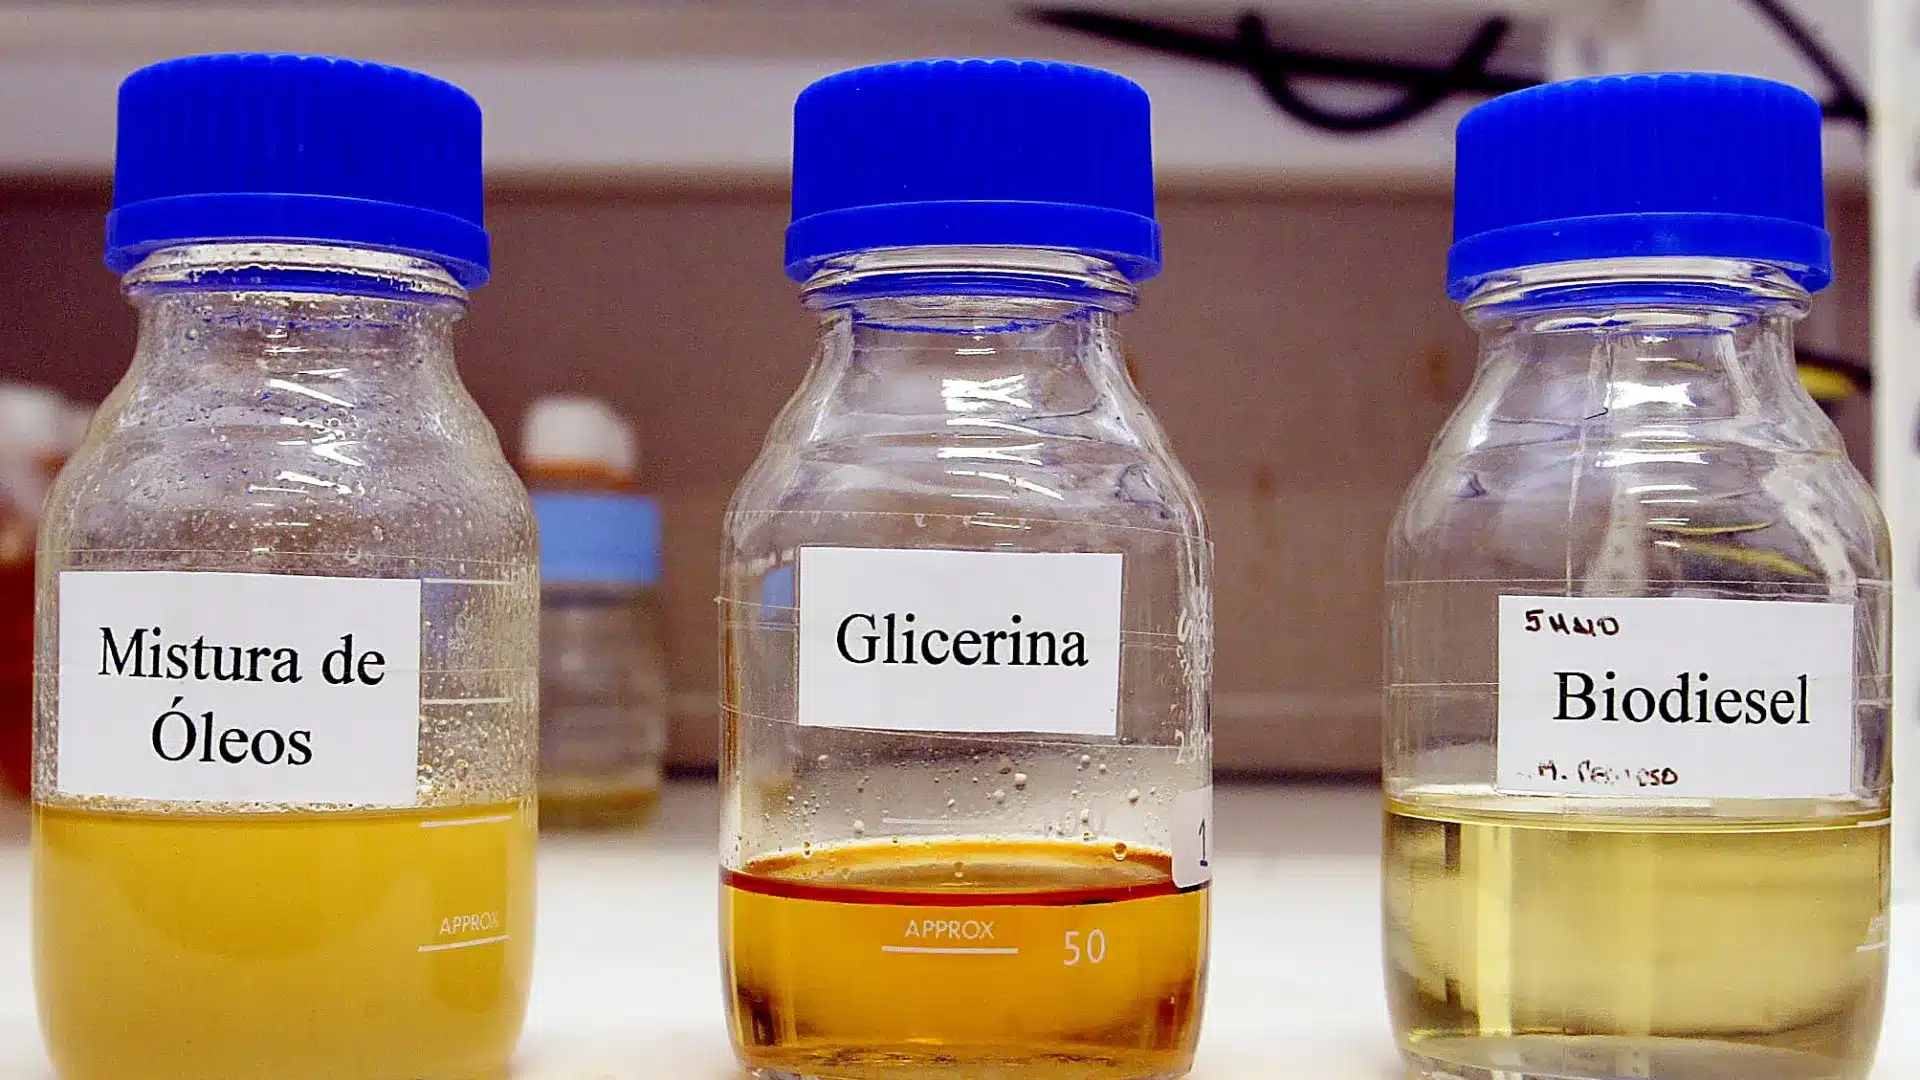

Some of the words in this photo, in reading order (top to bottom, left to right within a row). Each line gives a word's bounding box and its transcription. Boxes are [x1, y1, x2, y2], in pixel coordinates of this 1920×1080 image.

[98, 626, 303, 684] Mistura
[321, 633, 386, 686] de
[836, 613, 1090, 667] Glicerina
[1552, 671, 1810, 724] Biodiesel
[152, 695, 313, 767] Óleos
[440, 911, 501, 935] APPROX
[904, 919, 996, 940] APPROX
[1062, 928, 1107, 966] 50
